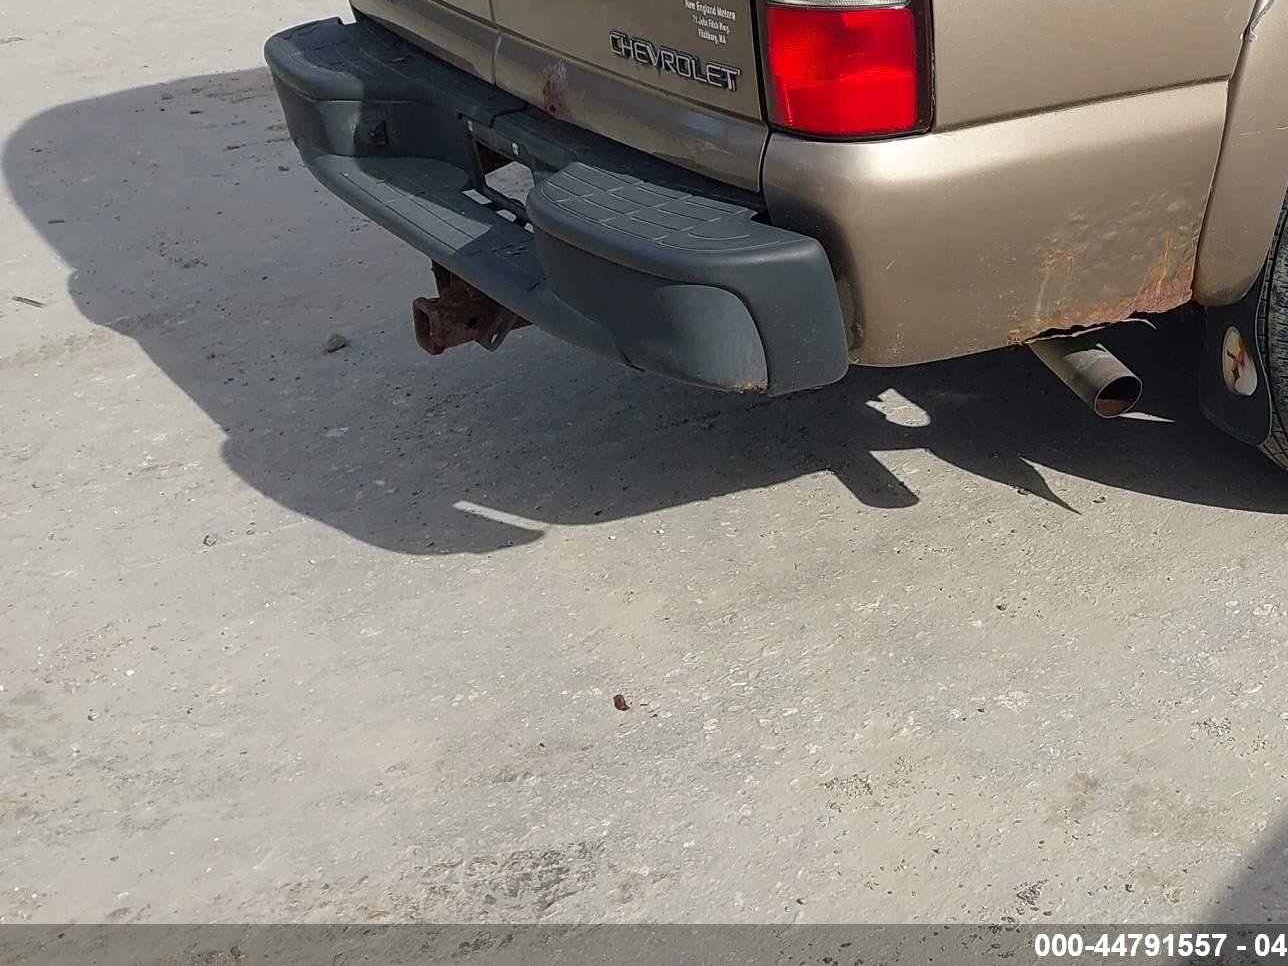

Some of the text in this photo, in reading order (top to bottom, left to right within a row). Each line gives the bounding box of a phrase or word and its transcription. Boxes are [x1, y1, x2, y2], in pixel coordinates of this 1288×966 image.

[696, 1, 717, 16] England
[717, 6, 736, 21] Motors
[718, 34, 727, 43] MA
[609, 31, 741, 91] CHEVROLET
